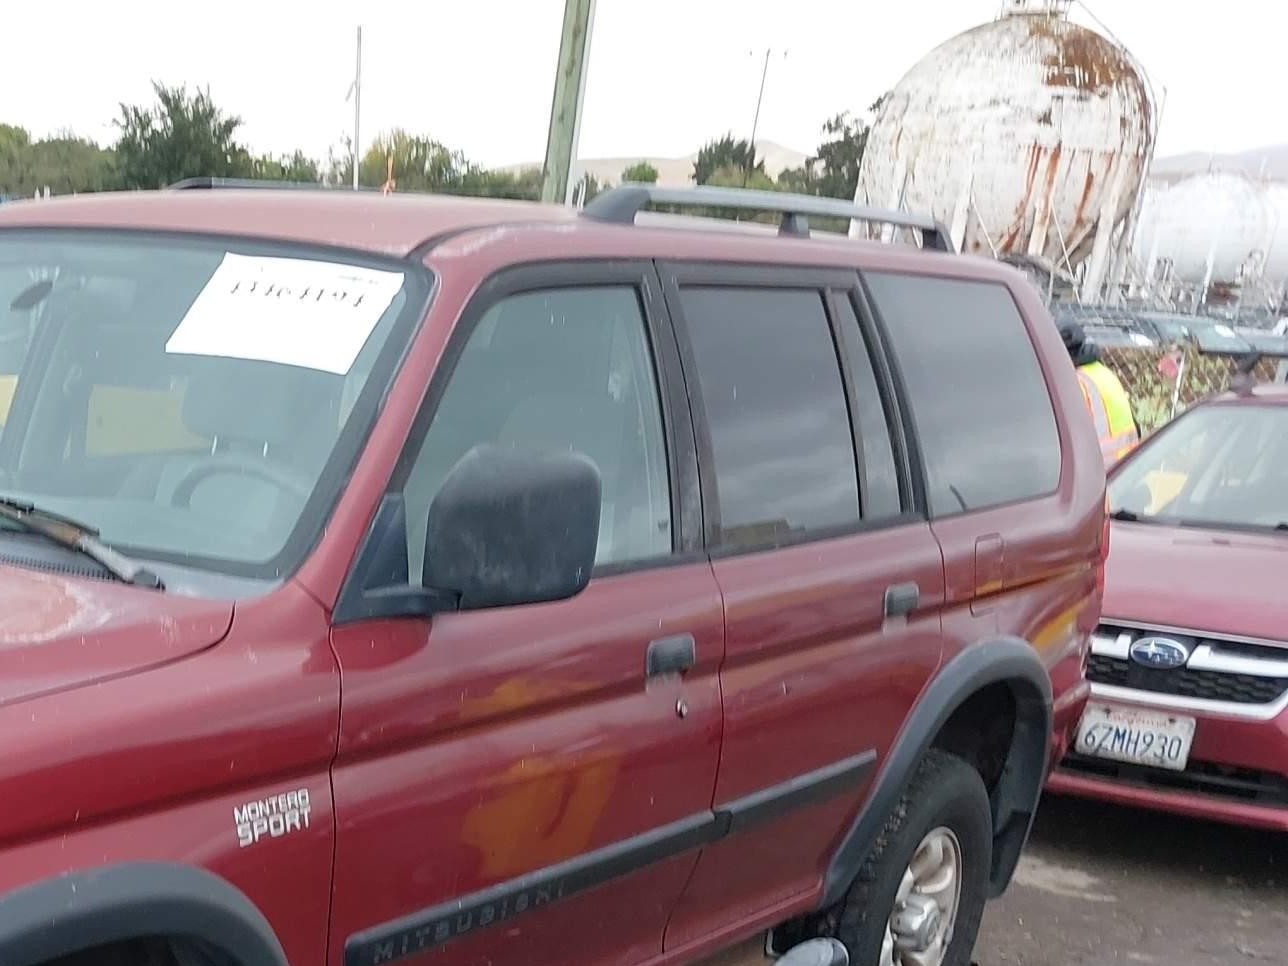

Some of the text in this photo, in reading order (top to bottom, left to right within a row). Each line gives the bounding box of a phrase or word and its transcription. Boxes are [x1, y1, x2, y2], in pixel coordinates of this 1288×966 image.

[1083, 722, 1183, 762] 6ZMH930
[233, 788, 311, 825] MONTERO
[236, 805, 312, 848] SPORT
